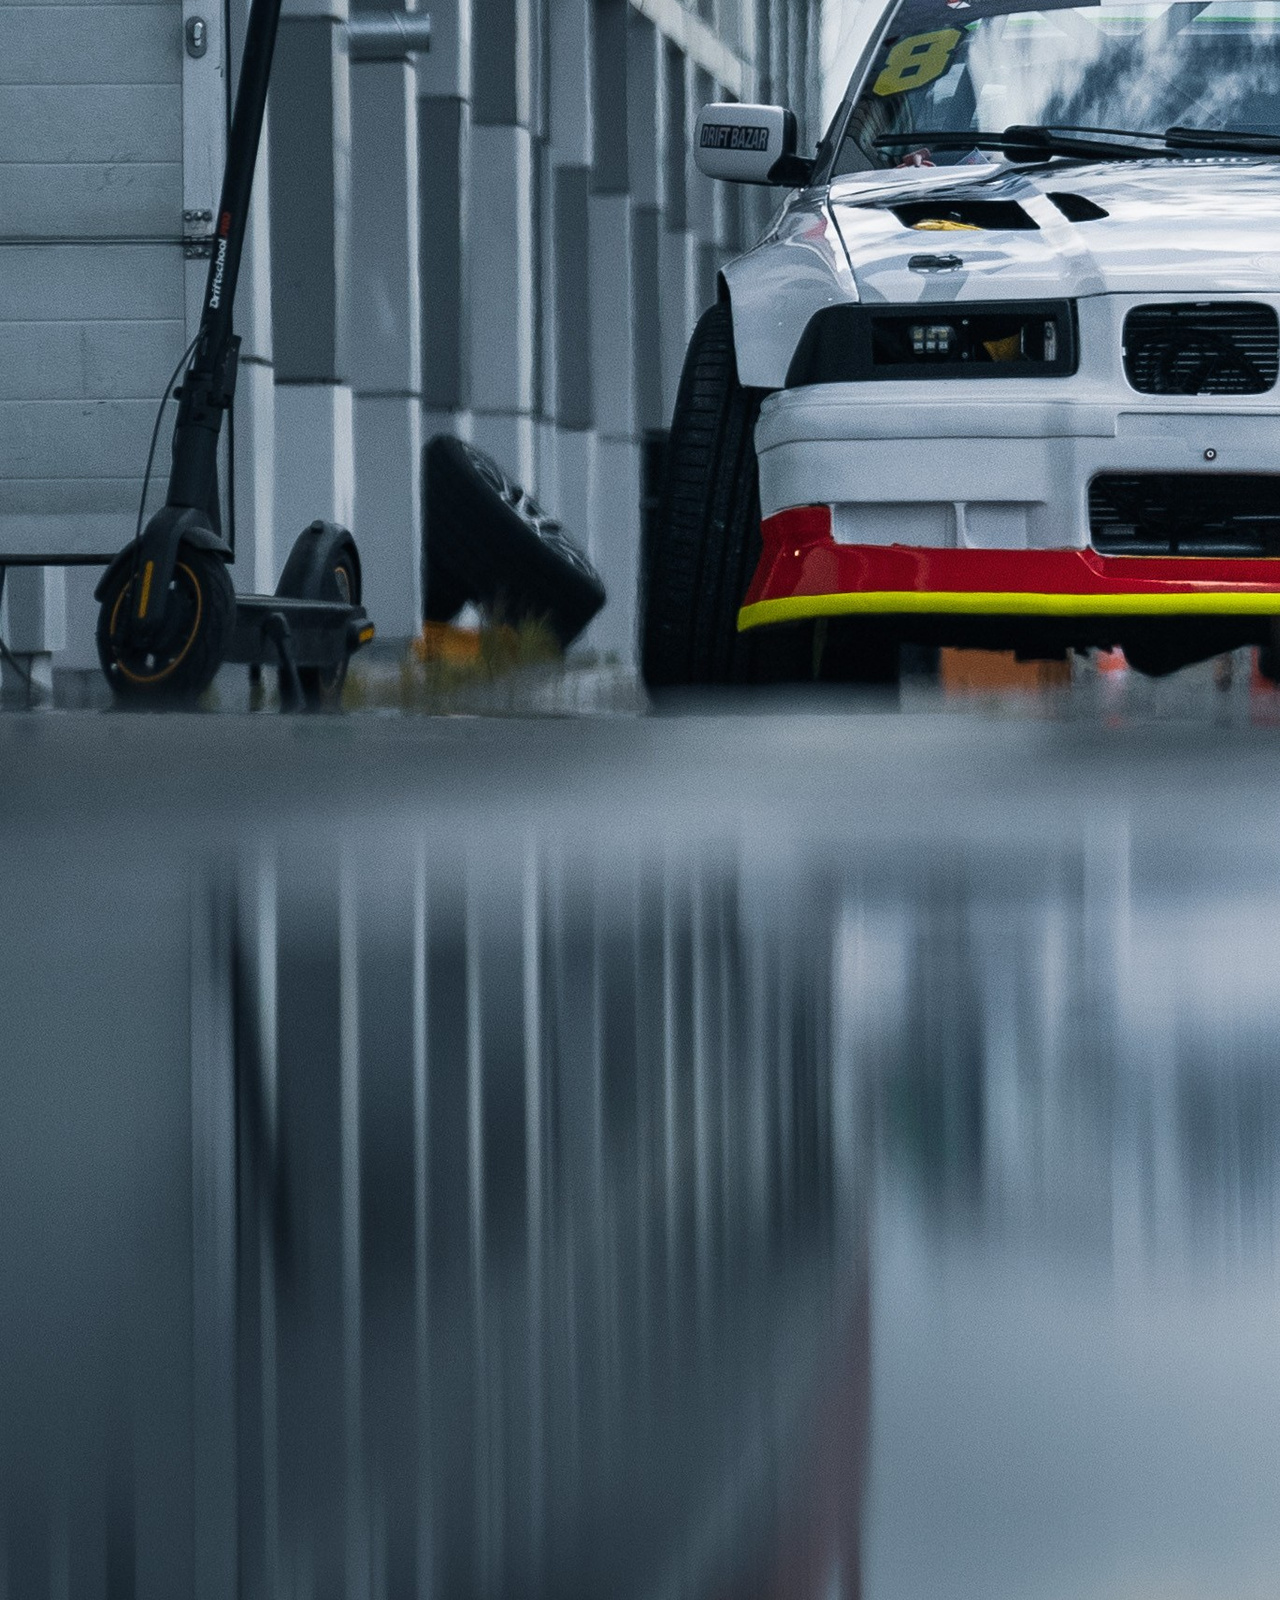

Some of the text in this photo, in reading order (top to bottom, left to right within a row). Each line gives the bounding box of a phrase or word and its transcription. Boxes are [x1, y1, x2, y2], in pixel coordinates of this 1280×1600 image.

[872, 28, 962, 97] 8
[701, 125, 768, 150] DRIFT BAZAR
[208, 238, 227, 309] Driftschool
